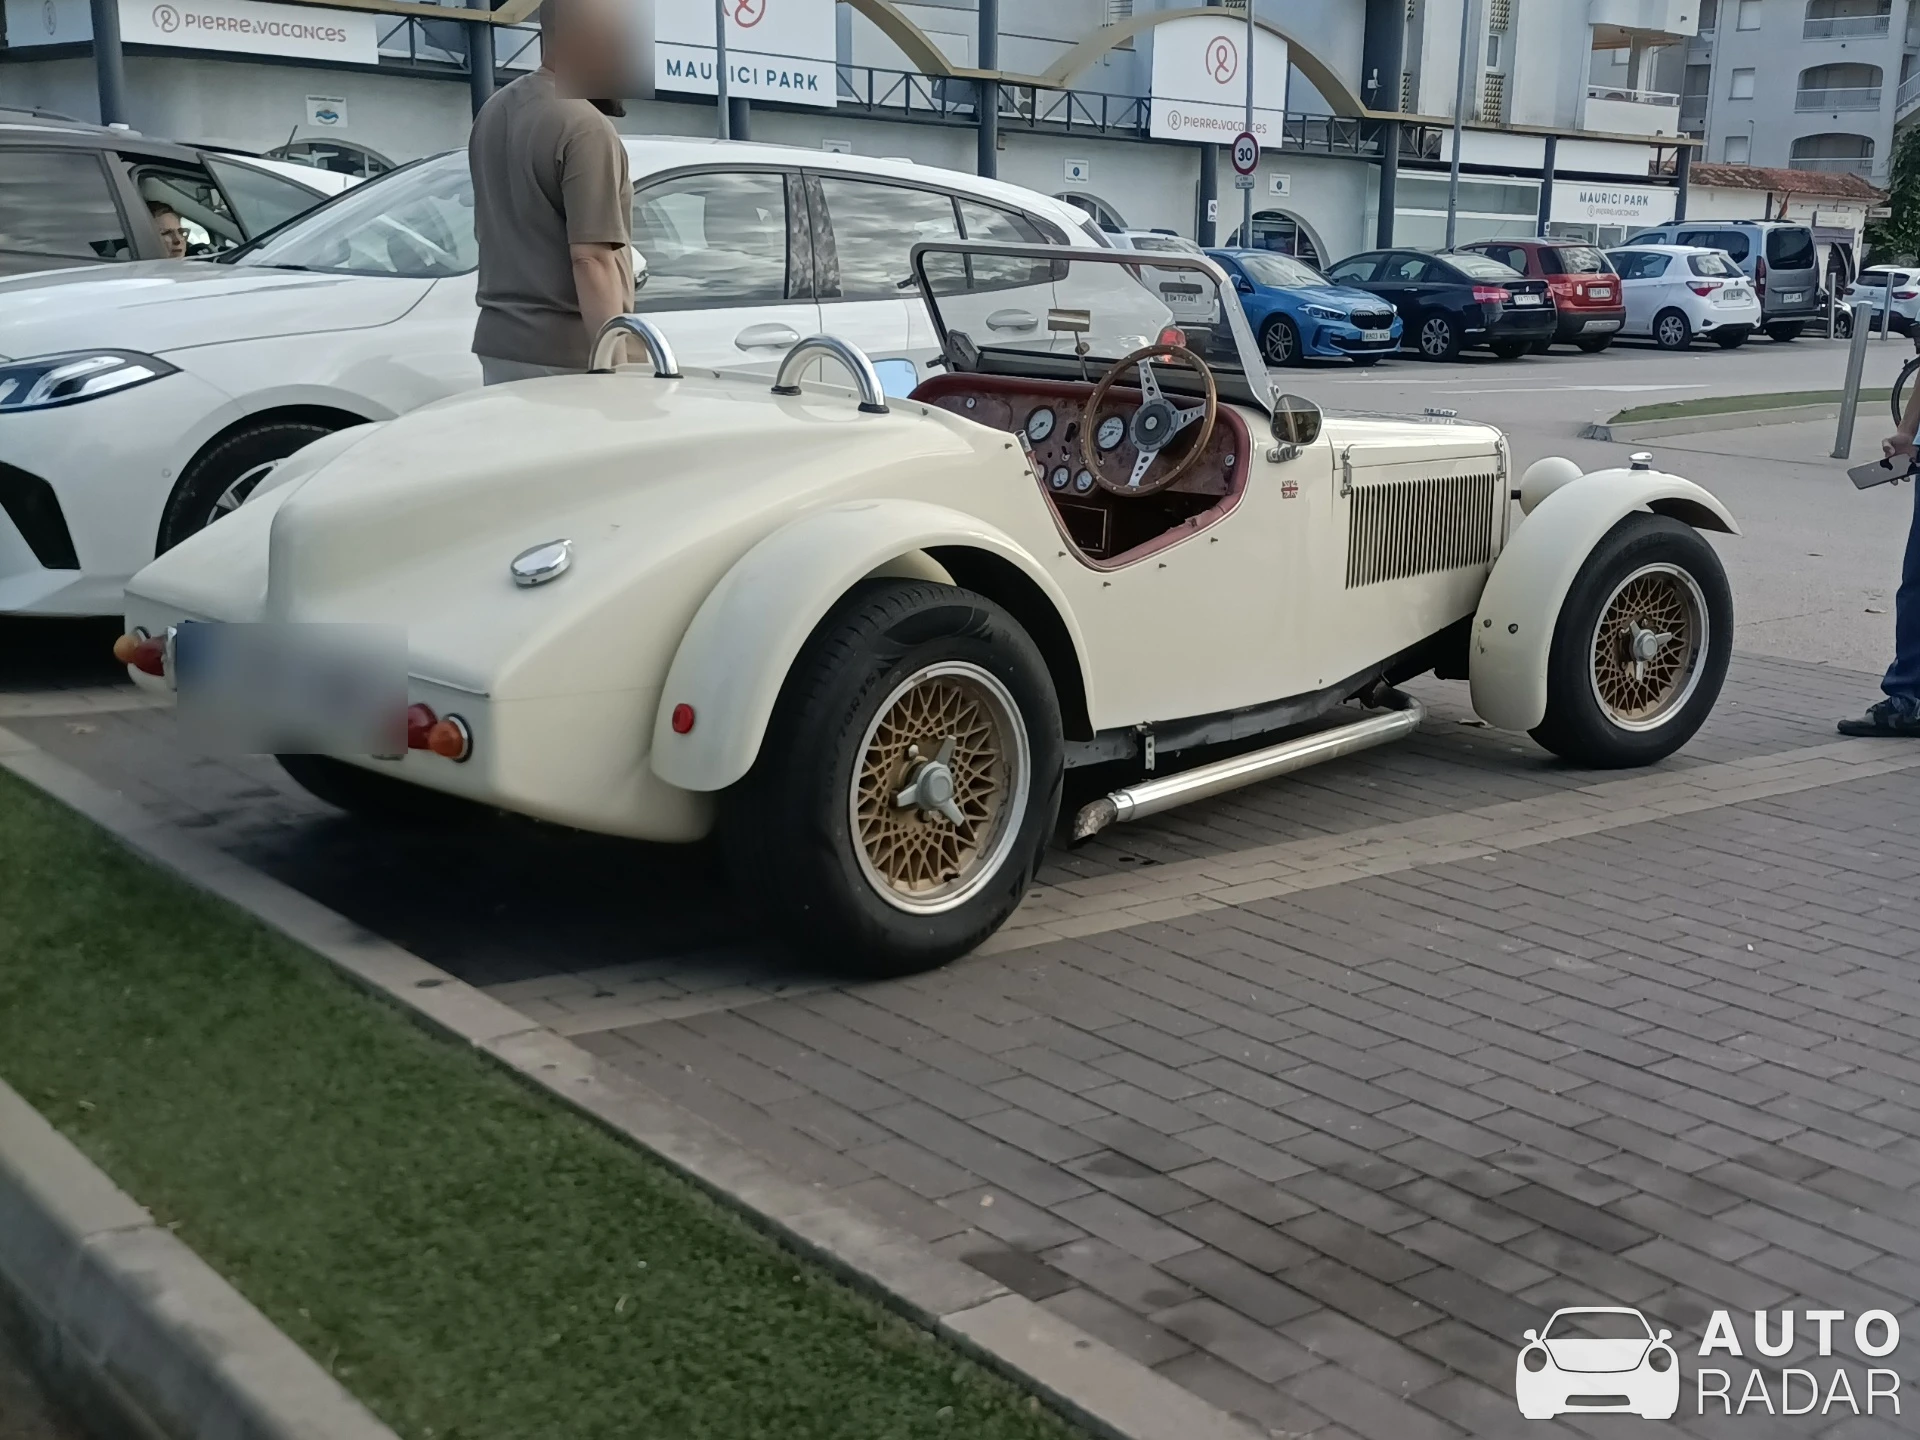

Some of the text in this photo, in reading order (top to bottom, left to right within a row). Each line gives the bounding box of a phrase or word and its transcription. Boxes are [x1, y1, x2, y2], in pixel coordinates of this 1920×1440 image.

[666, 58, 819, 91] MAUICI PARK
[1238, 147, 1253, 161] 30
[1579, 191, 1649, 206] MAURICI PARK
